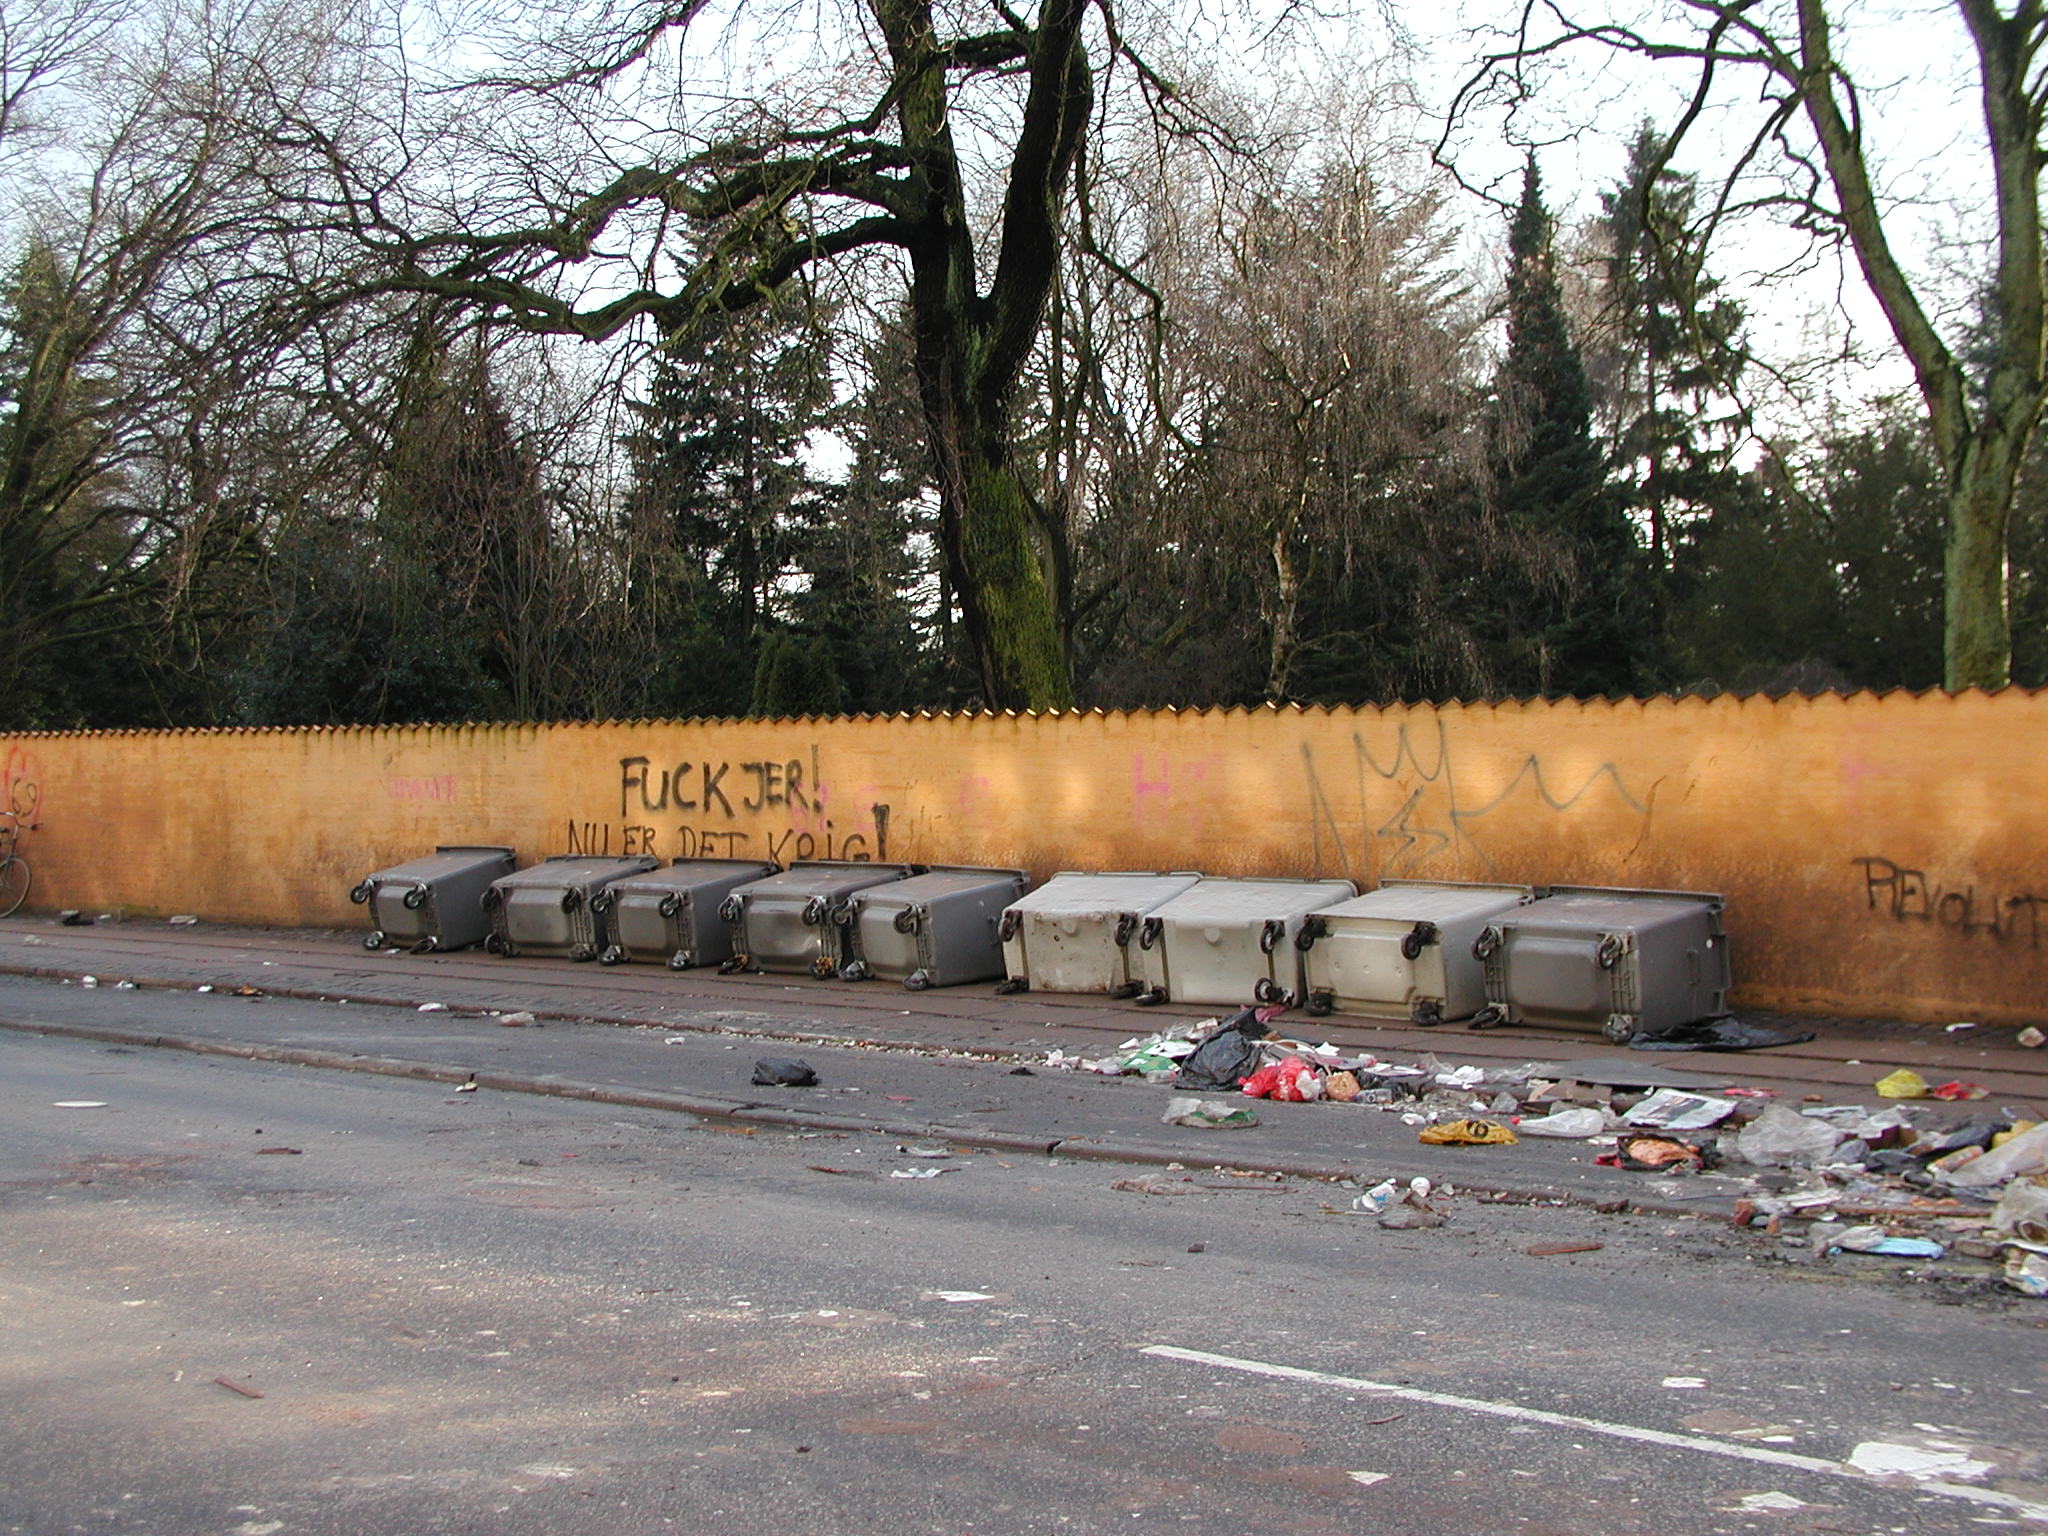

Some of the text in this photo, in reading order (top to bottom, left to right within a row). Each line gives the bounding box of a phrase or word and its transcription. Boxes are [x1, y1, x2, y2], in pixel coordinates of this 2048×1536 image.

[620, 756, 734, 818] FUCK
[740, 744, 823, 814] JER!
[568, 819, 609, 857] NU
[622, 825, 657, 857] ER
[677, 824, 749, 858] DET
